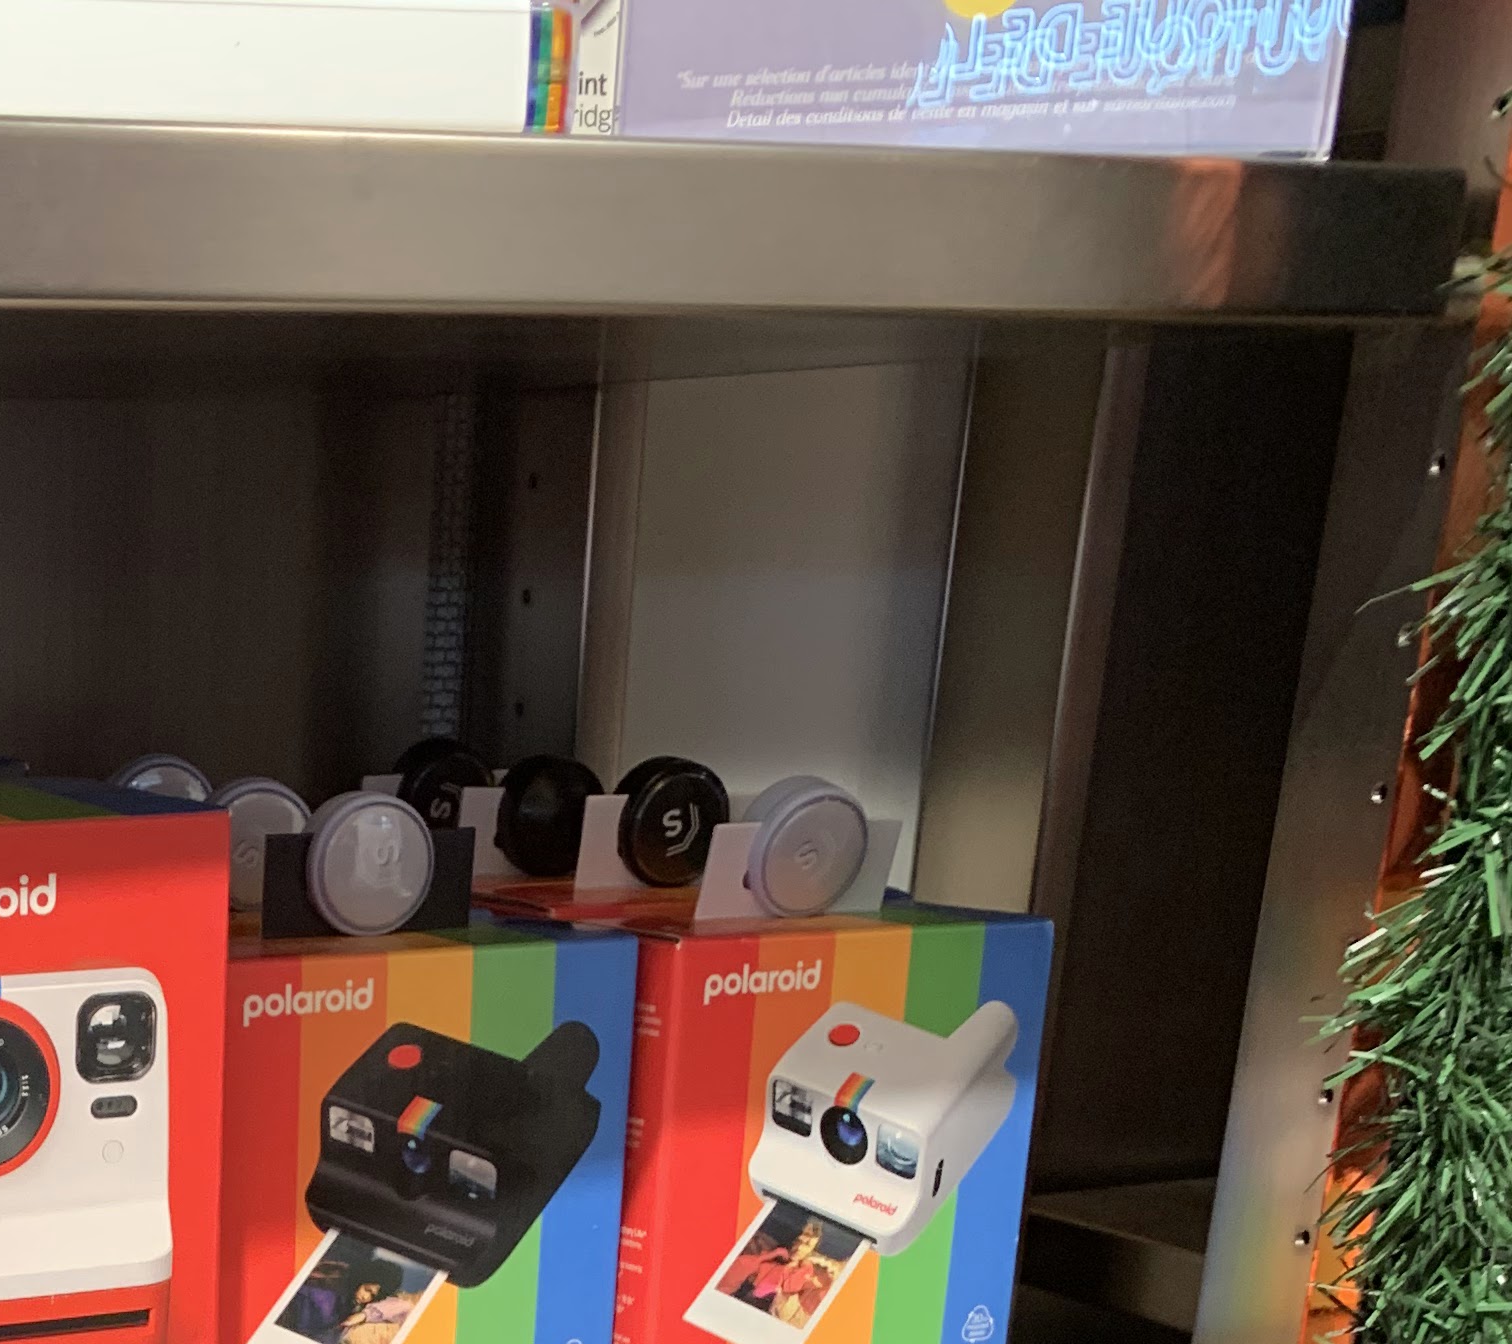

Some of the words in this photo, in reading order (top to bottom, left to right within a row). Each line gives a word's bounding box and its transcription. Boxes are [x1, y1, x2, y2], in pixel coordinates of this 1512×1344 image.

[776, 109, 801, 126] des
[703, 959, 823, 1005] polaroid
[242, 978, 375, 1028] polaroid
[853, 1193, 898, 1216] polaroid
